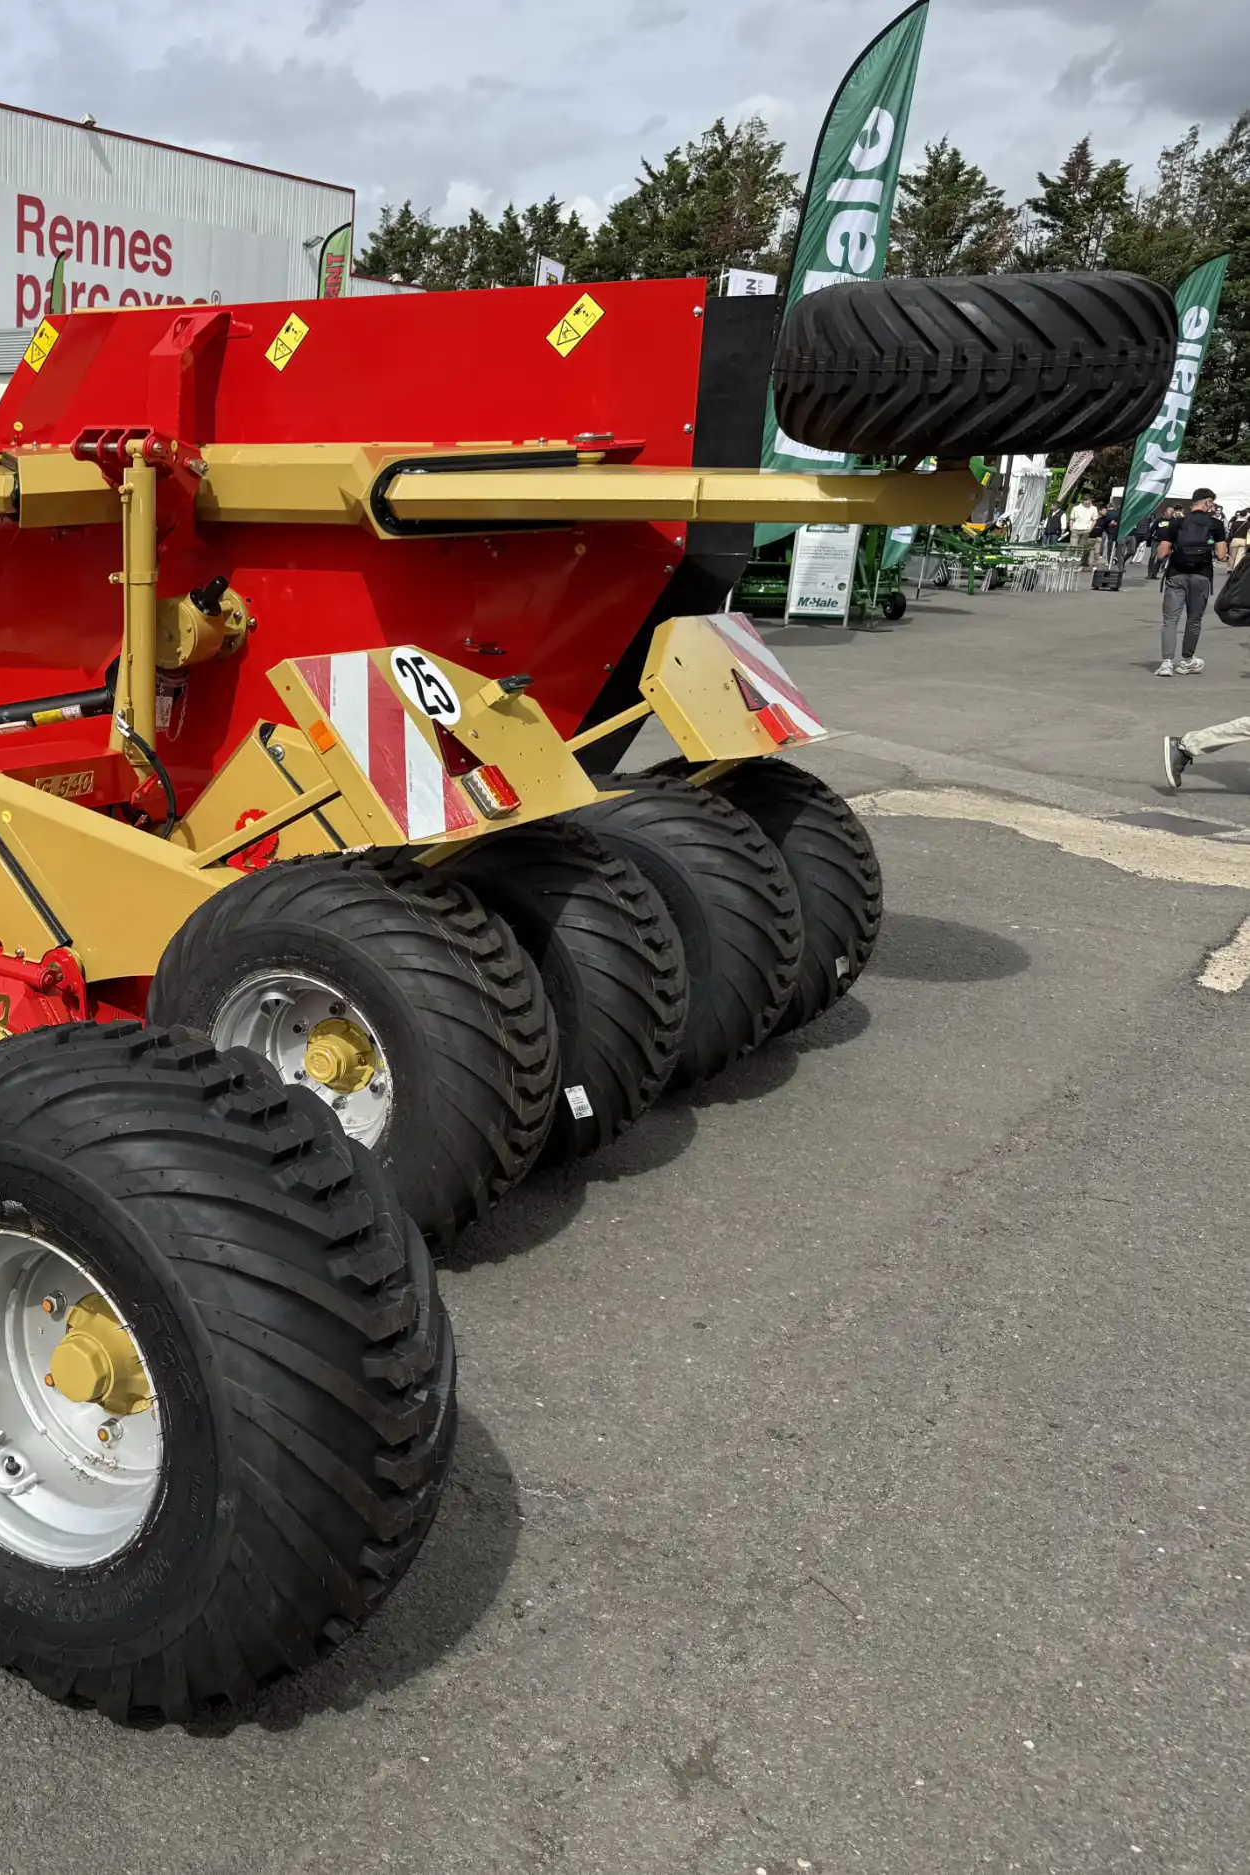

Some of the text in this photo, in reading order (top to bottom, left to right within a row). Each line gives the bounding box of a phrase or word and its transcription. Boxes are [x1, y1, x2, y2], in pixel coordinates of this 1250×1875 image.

[16, 193, 173, 277] Rennes
[395, 656, 456, 716] 25
[59, 772, 92, 798] 540
